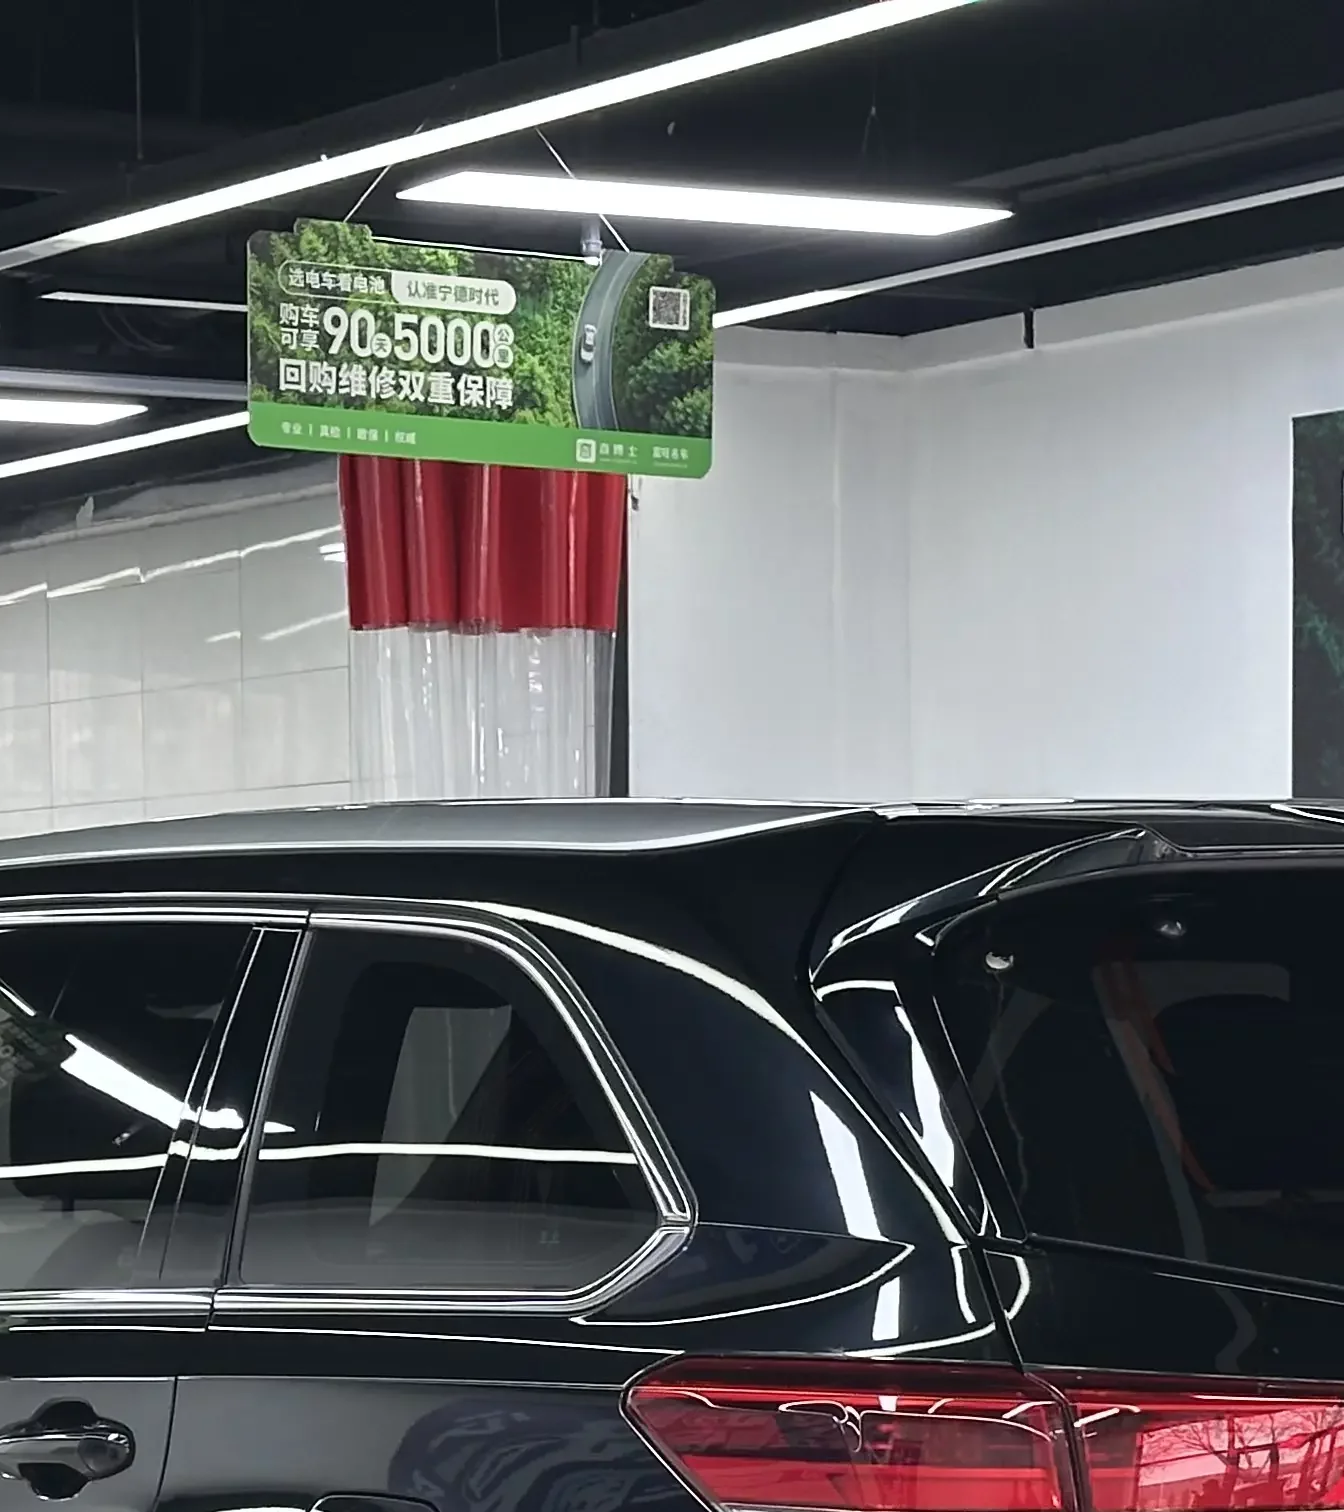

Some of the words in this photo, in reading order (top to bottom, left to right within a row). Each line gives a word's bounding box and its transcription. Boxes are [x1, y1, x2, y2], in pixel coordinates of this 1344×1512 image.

[288, 268, 385, 293] 选电车看电池
[407, 280, 500, 306] 认准宁德时代
[279, 302, 320, 327] 购车
[279, 327, 320, 351] 可享
[279, 357, 513, 409] 回购维修双重保障
